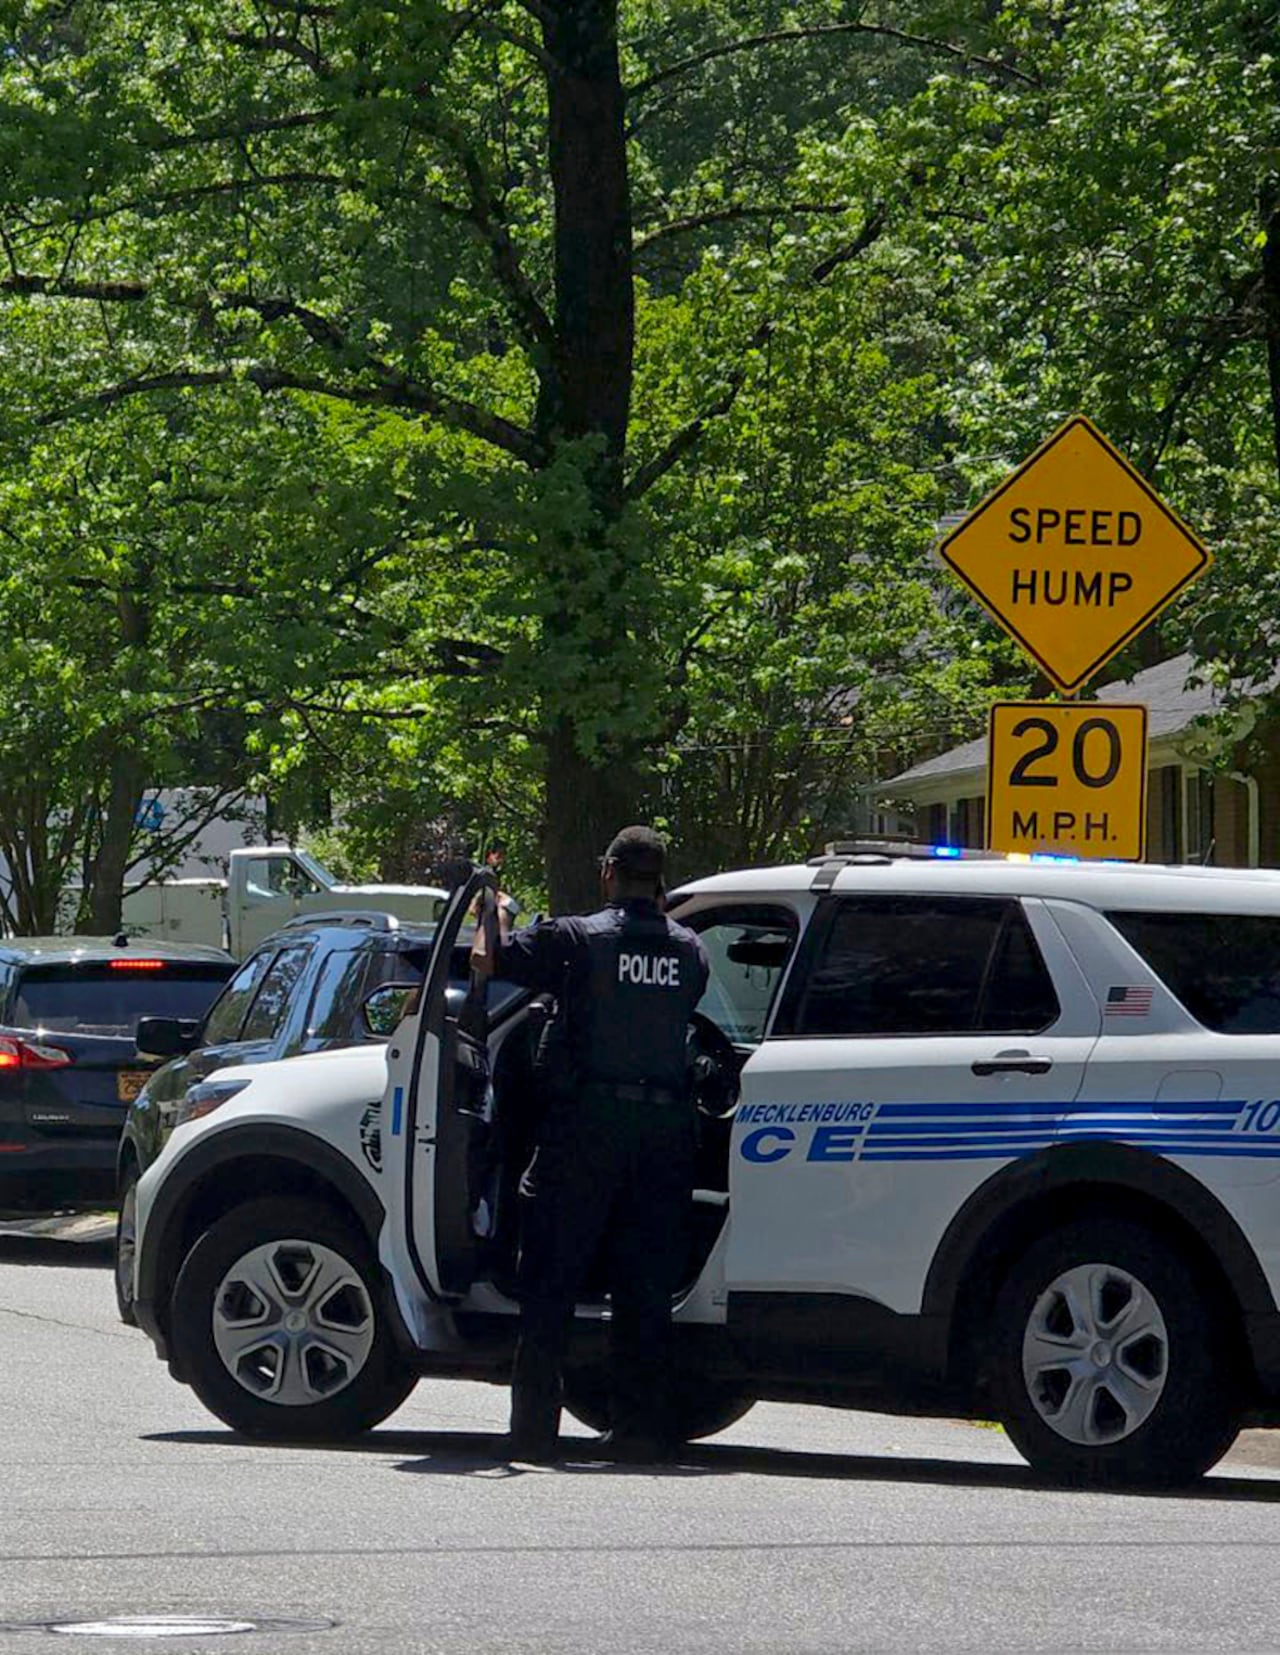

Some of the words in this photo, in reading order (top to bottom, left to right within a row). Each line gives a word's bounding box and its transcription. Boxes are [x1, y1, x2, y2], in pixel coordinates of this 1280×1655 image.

[1008, 507, 1142, 546] SPEED
[1012, 569, 1133, 607] HUMP
[1009, 717, 1122, 788] 20
[1012, 810, 1118, 841] M.P.H.
[618, 953, 680, 986] POLICE
[736, 1102, 874, 1124] MECKLENBURG
